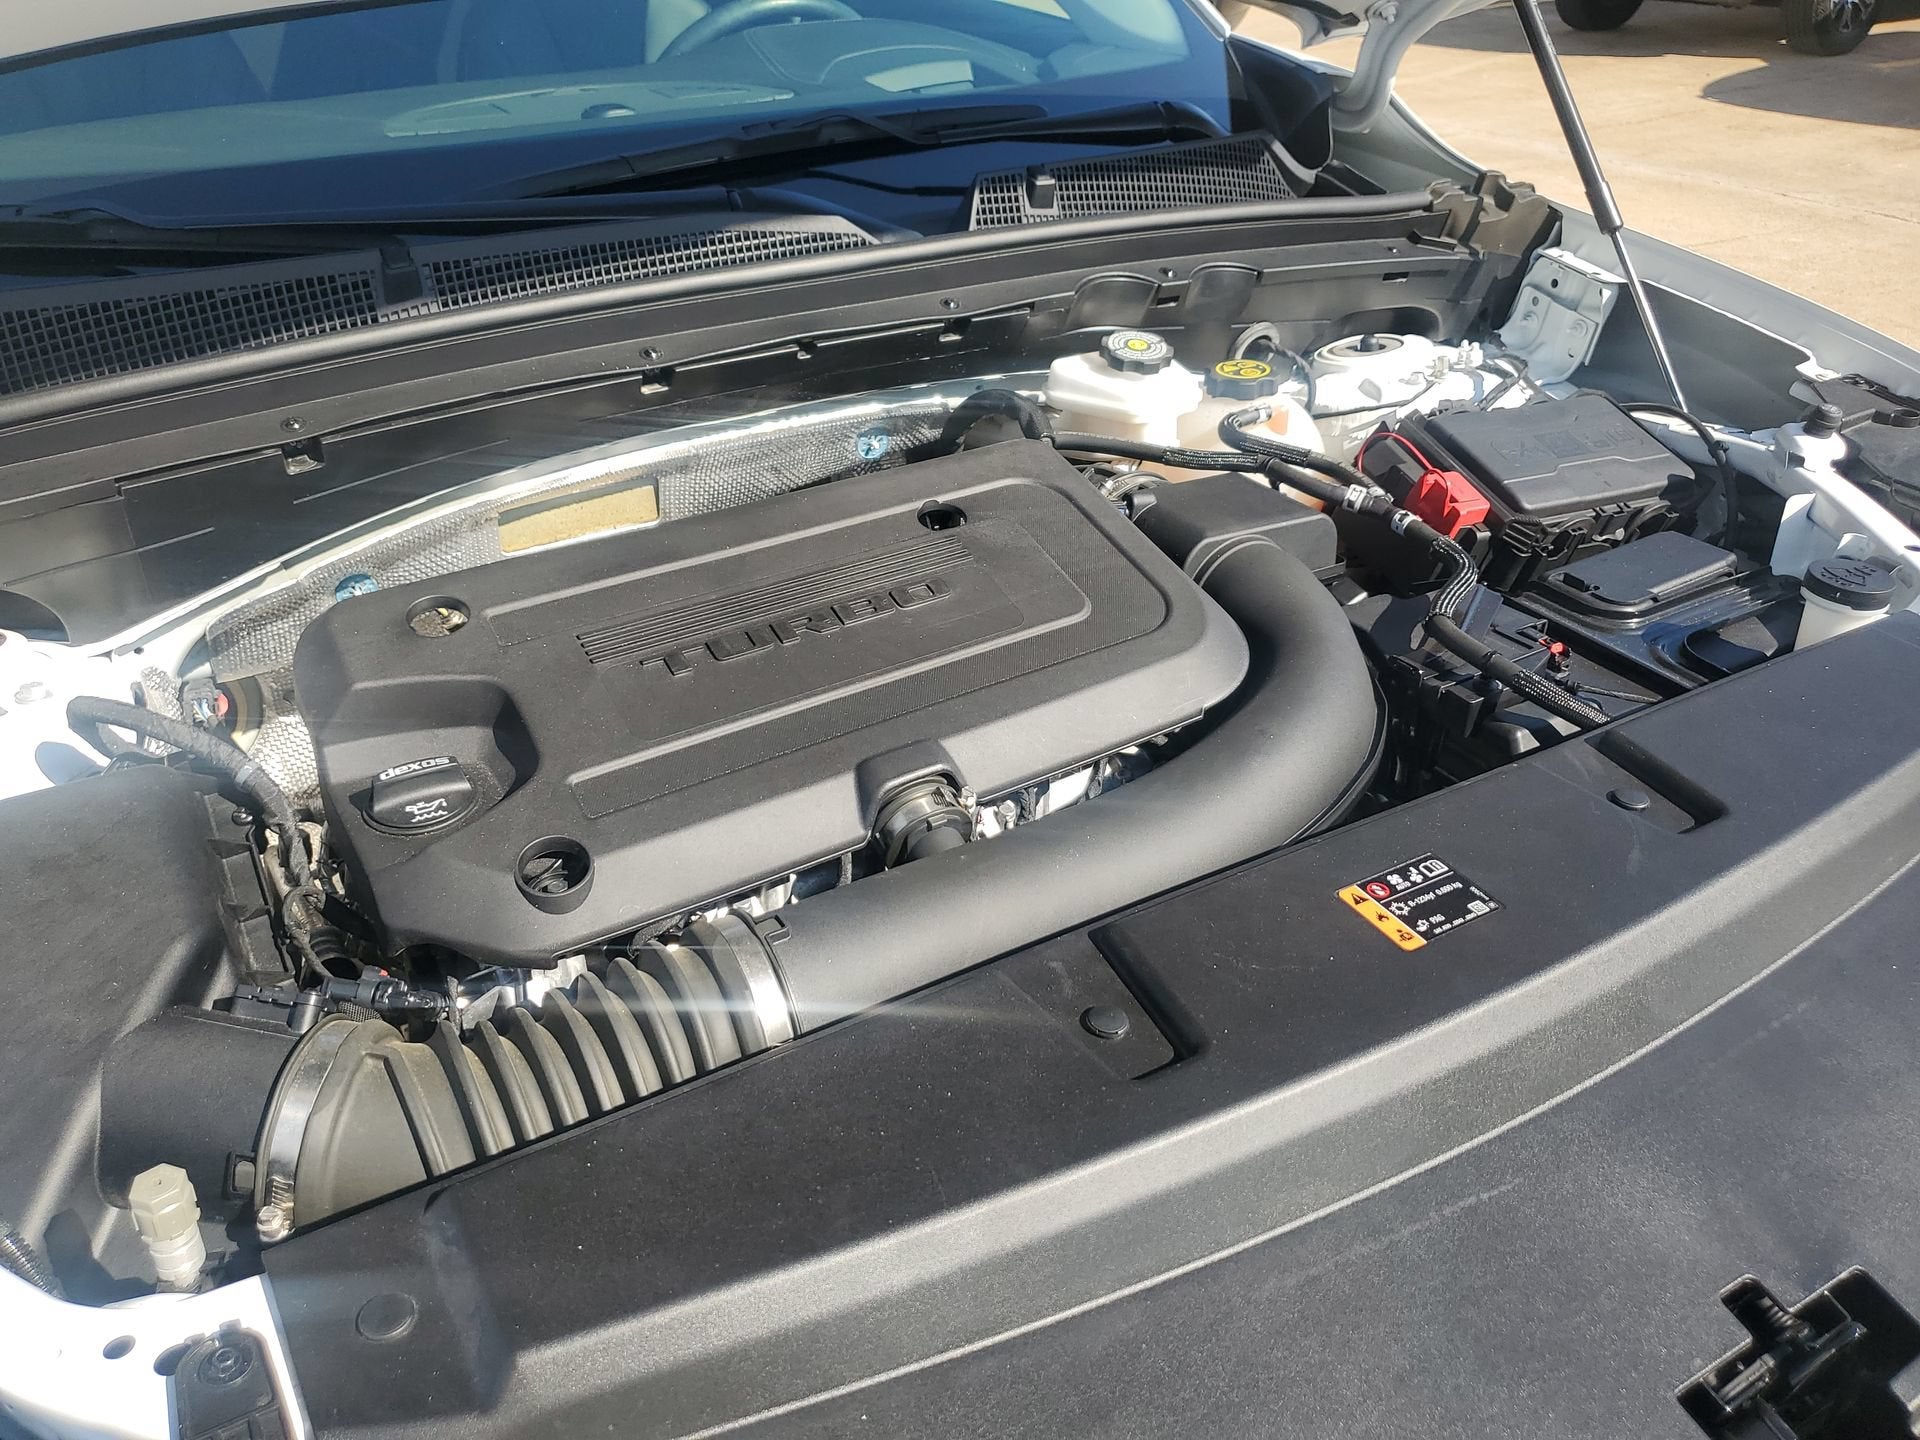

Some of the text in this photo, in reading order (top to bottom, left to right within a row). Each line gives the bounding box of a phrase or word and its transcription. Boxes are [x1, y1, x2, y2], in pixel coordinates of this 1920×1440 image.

[640, 578, 952, 676] TURBO
[378, 756, 450, 781] dexos
[1429, 913, 1446, 925] PAG
